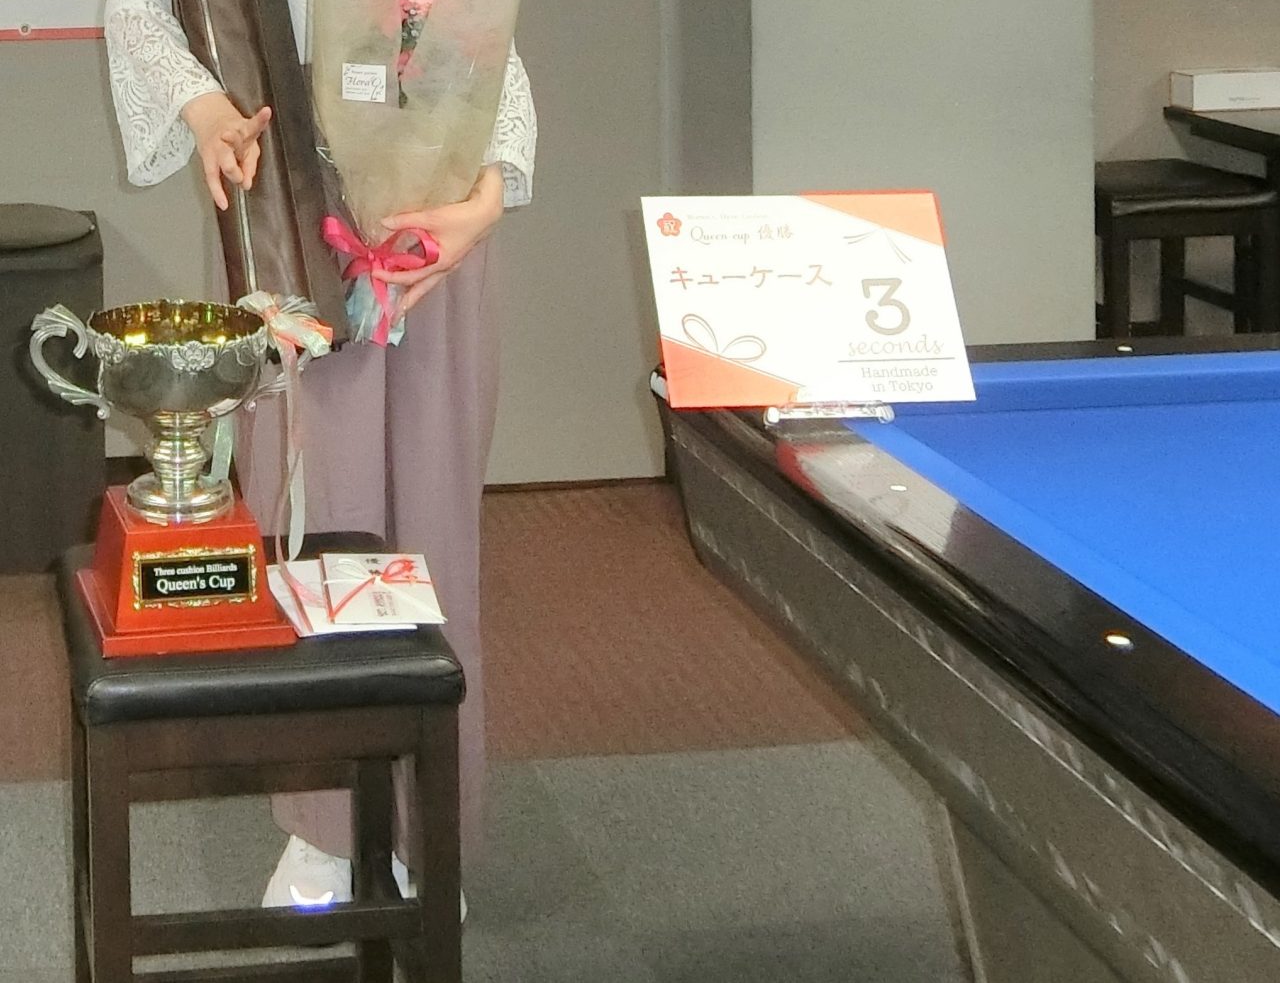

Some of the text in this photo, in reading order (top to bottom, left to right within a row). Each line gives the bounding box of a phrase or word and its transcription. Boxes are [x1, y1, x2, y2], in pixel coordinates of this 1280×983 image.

[669, 264, 833, 291] キューケース
[861, 278, 911, 336] 3
[847, 333, 945, 356] seconds
[860, 365, 939, 379] Handmade
[871, 379, 935, 394] in Tokyo
[153, 567, 176, 577] Three
[206, 562, 238, 573] Billiards
[156, 574, 236, 595] Queen's Cup
